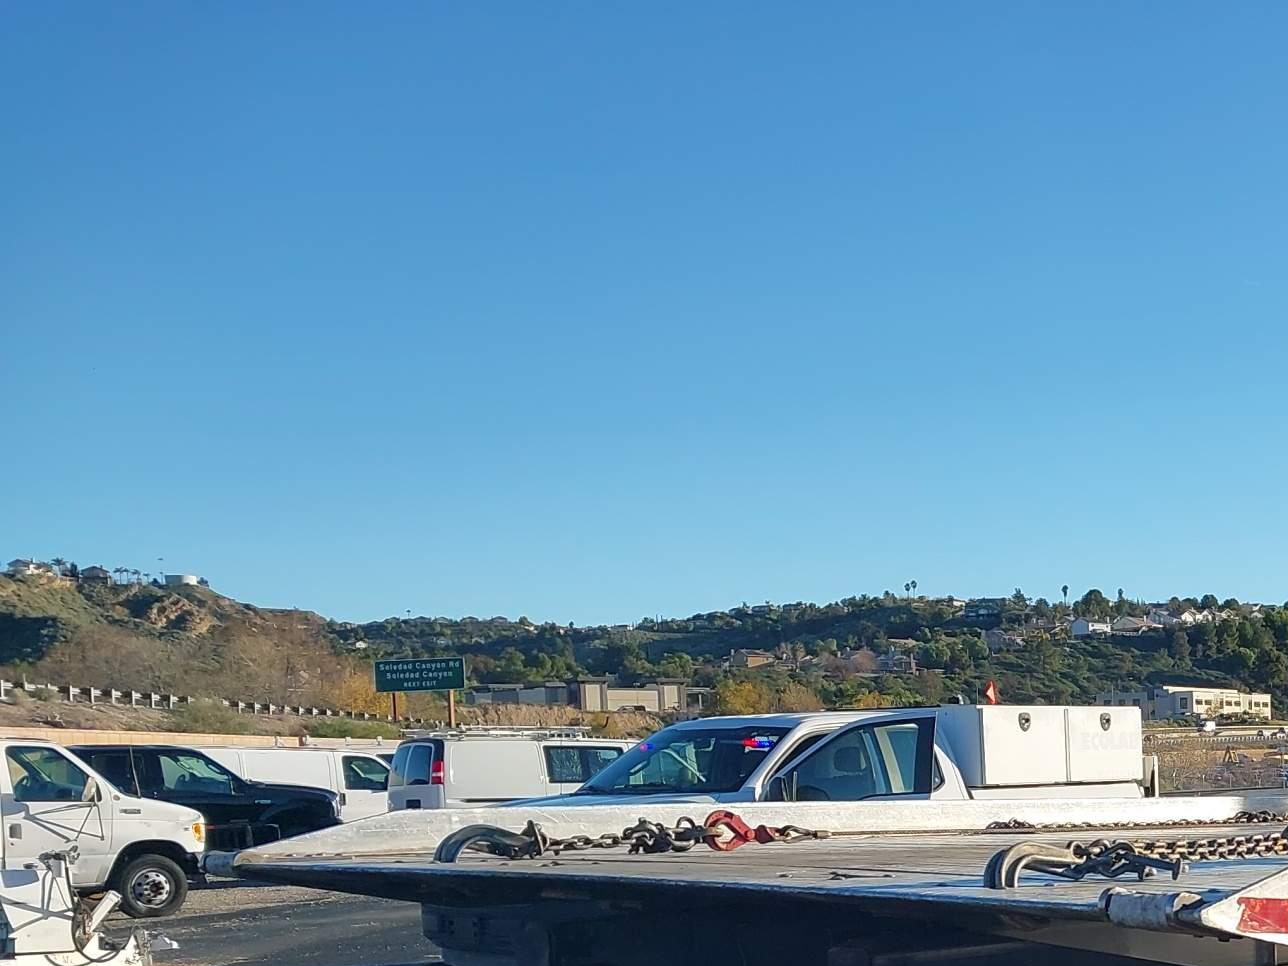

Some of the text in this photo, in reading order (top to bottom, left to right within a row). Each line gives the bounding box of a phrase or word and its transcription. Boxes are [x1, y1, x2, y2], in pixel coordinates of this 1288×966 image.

[379, 663, 413, 671] Soledad
[415, 661, 446, 671] Canyon
[386, 671, 453, 679] Soledad Canyon
